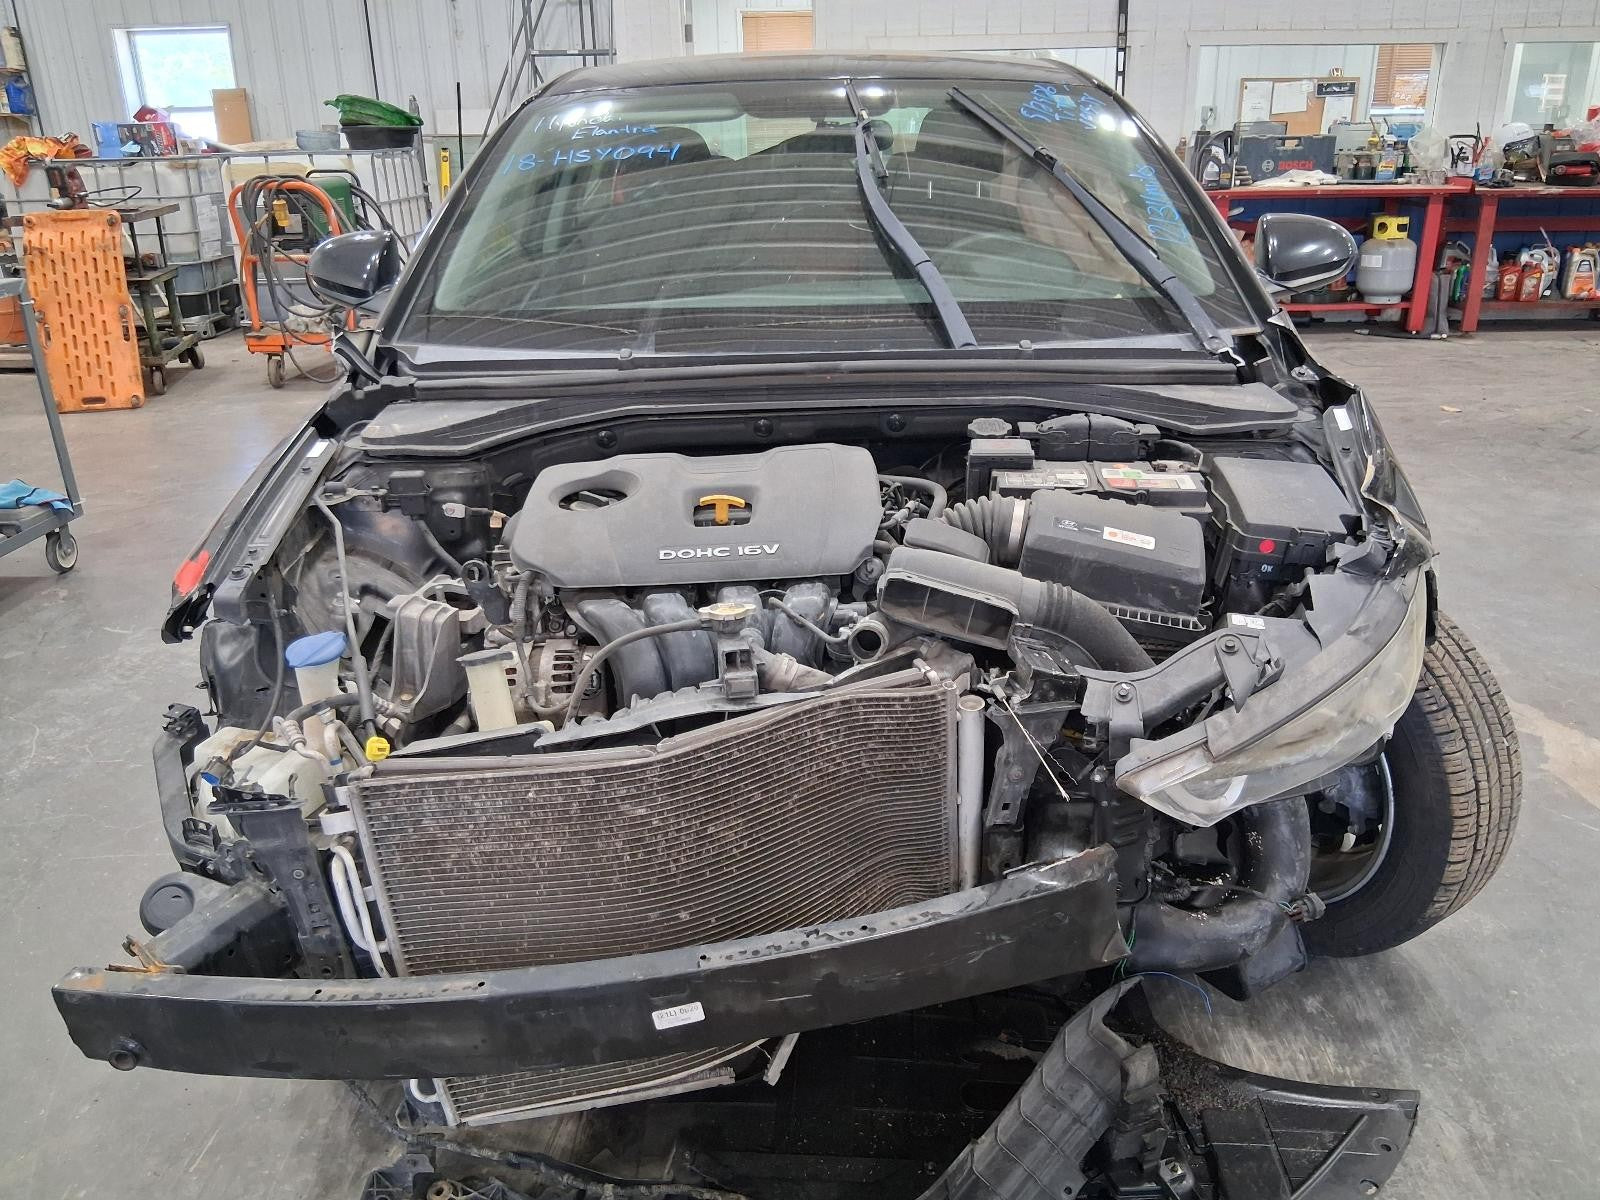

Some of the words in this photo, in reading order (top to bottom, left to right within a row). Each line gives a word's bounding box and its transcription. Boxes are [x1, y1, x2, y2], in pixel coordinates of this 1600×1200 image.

[1278, 159, 1314, 171] BOSCH
[659, 546, 731, 560] DOHC
[737, 543, 780, 556] 16V
[1260, 563, 1274, 573] OK
